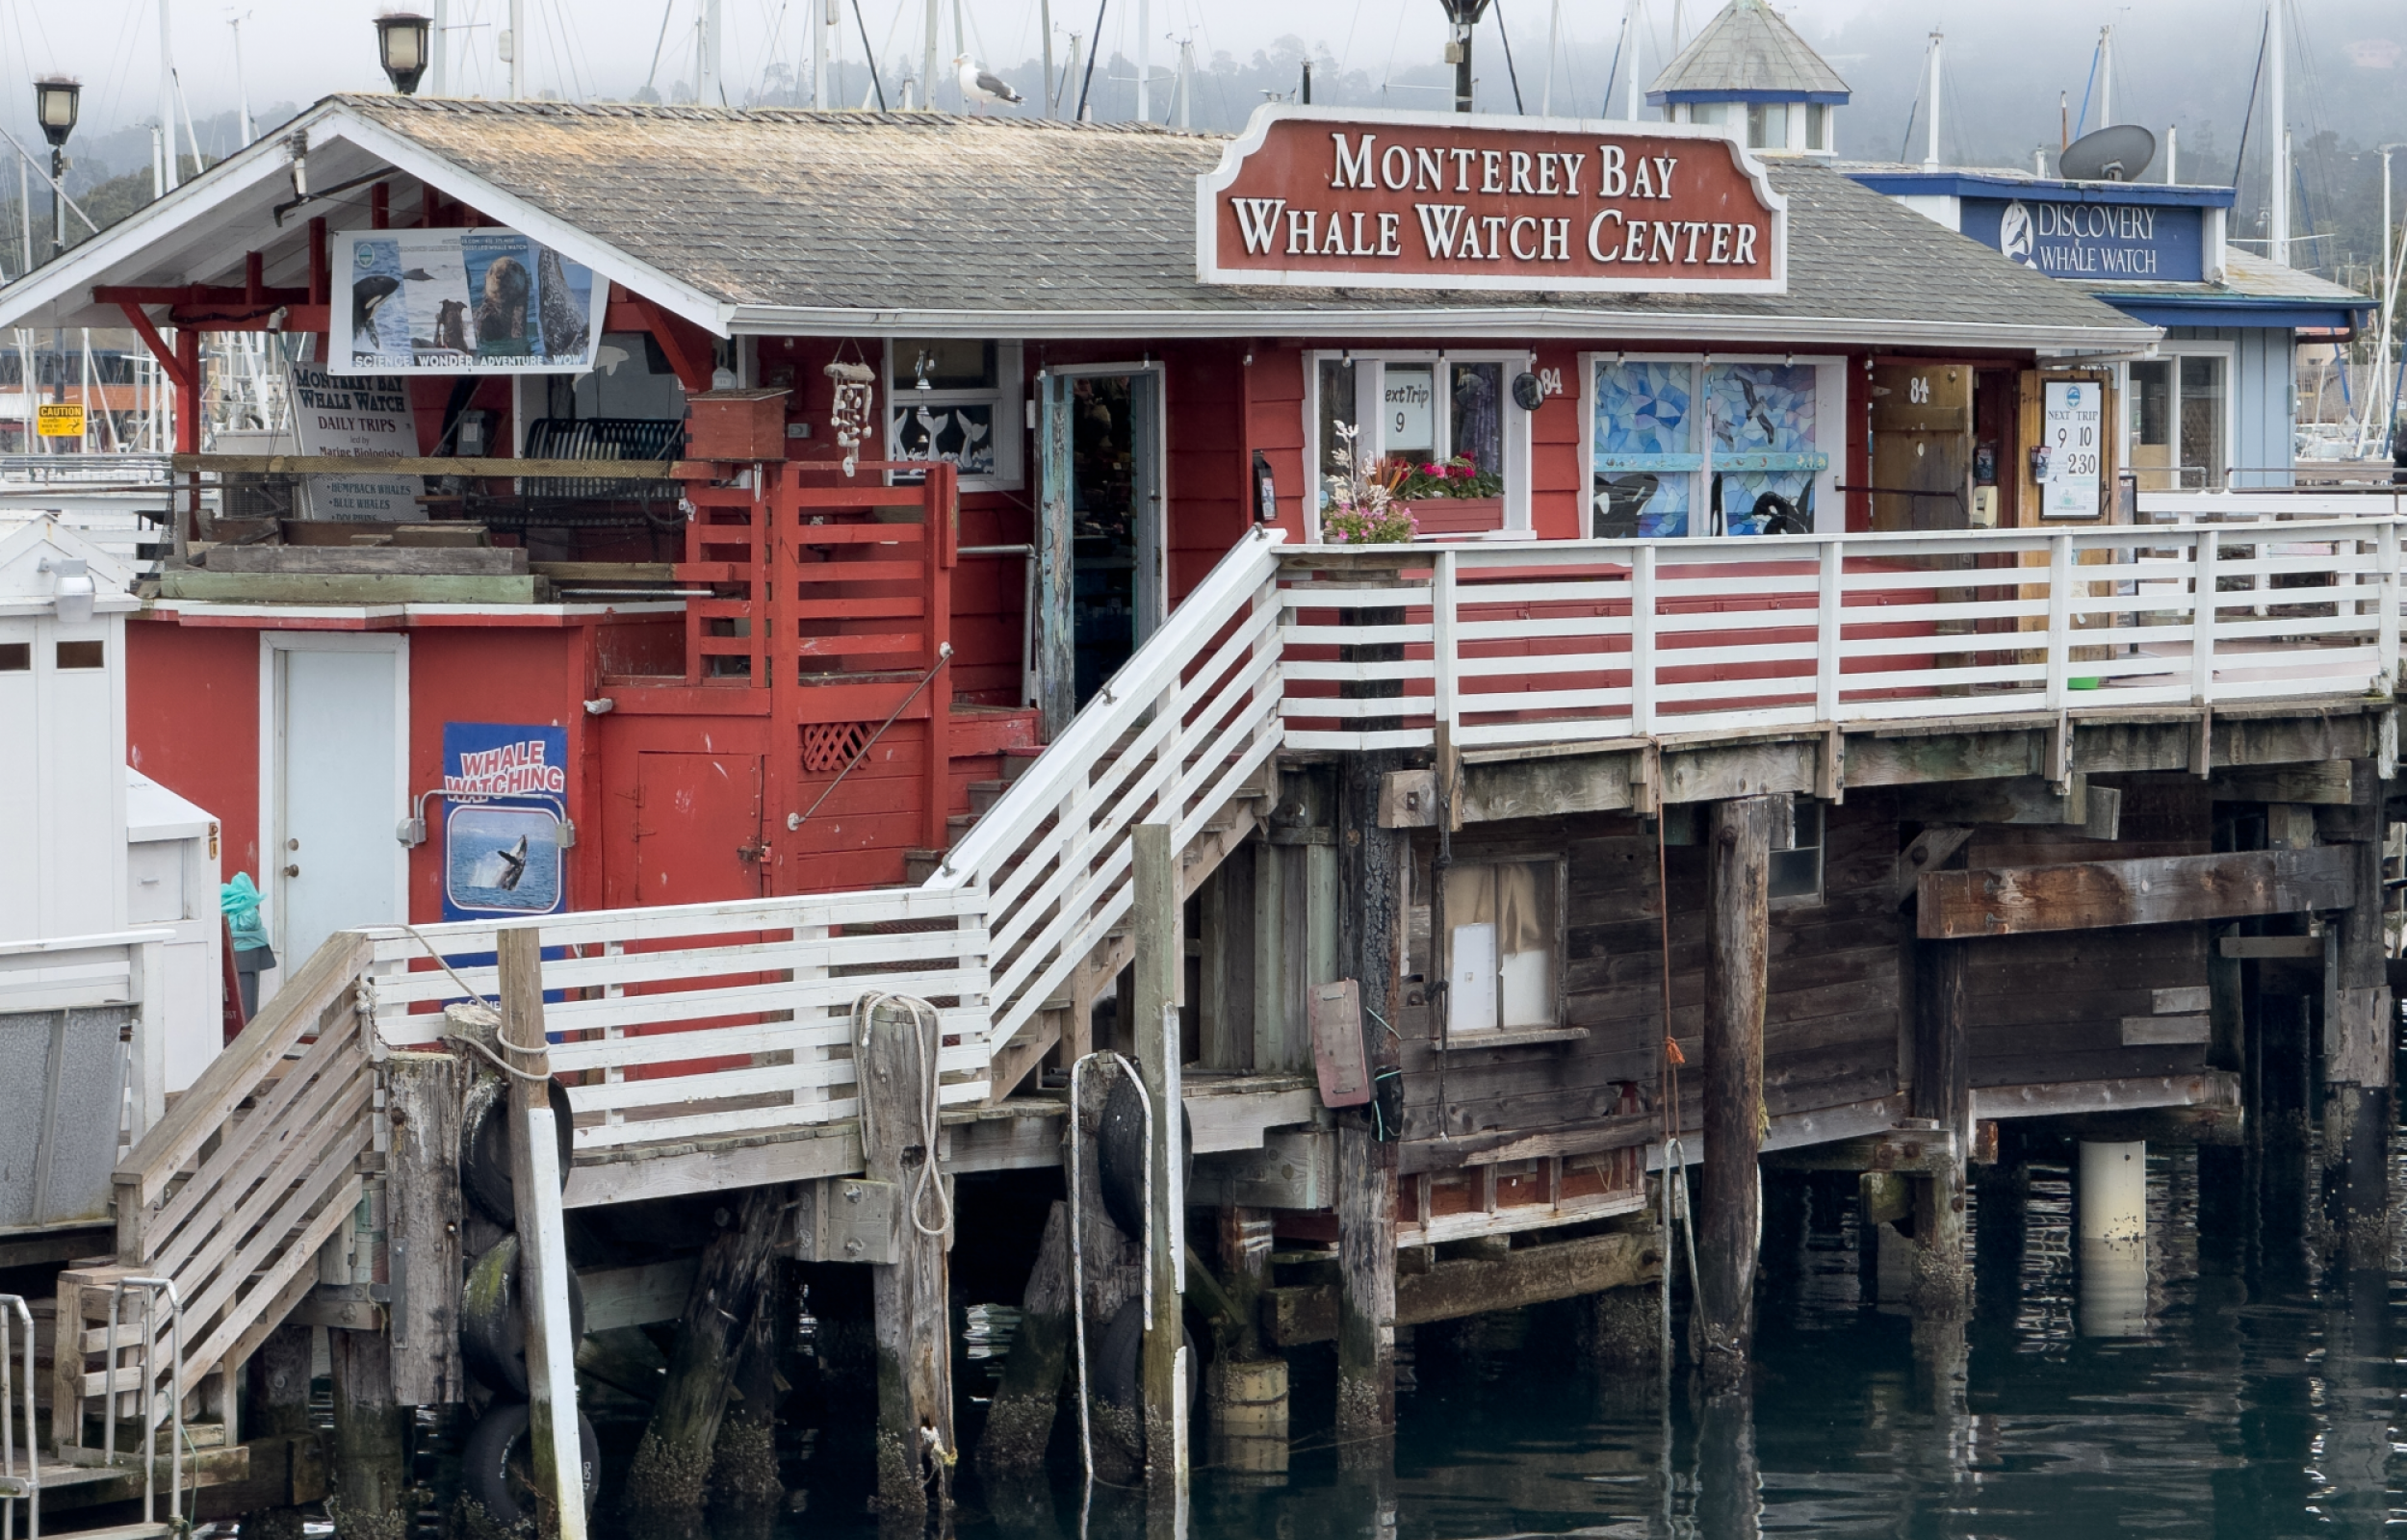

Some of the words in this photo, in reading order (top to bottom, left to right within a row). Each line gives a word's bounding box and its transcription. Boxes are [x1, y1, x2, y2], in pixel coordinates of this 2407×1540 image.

[1331, 133, 1587, 196] MONTEREY
[1597, 144, 1678, 199] BAY
[1230, 197, 1402, 257] WHALE
[1413, 203, 1571, 261] WATCH
[1588, 208, 1758, 266] CENTER
[2038, 202, 2157, 240] DISCOVERY
[2039, 245, 2097, 271] WHALE
[2100, 247, 2157, 274] WATCH
[355, 355, 410, 367] SCIENCE
[418, 354, 473, 367] WONDER
[480, 355, 544, 366] ADVENTURE
[552, 354, 583, 366] WOW
[294, 369, 373, 391] MONTEREY
[376, 374, 403, 393] BAY
[1540, 368, 1563, 396] 84
[1910, 376, 1929, 404] 84
[298, 389, 352, 410] WHALE
[353, 391, 406, 413] WATCH
[1385, 386, 1406, 404] ext
[41, 407, 82, 416] CAUTION
[1395, 412, 1406, 432] 9
[2048, 410, 2070, 421] NEXT
[2077, 410, 2098, 422] TRIP
[318, 416, 356, 431] DAILY
[358, 418, 397, 433] TRIPS
[349, 435, 360, 444] led
[361, 436, 370, 445] by
[2058, 427, 2067, 449] 9
[2079, 426, 2092, 447] 10
[319, 446, 351, 457] Marine
[2068, 453, 2096, 475] 230
[377, 484, 411, 495] WHALES
[333, 498, 354, 507] BLUE
[356, 499, 390, 509] WHALES
[460, 740, 546, 778] WHALE
[444, 765, 564, 803] WATCHING
